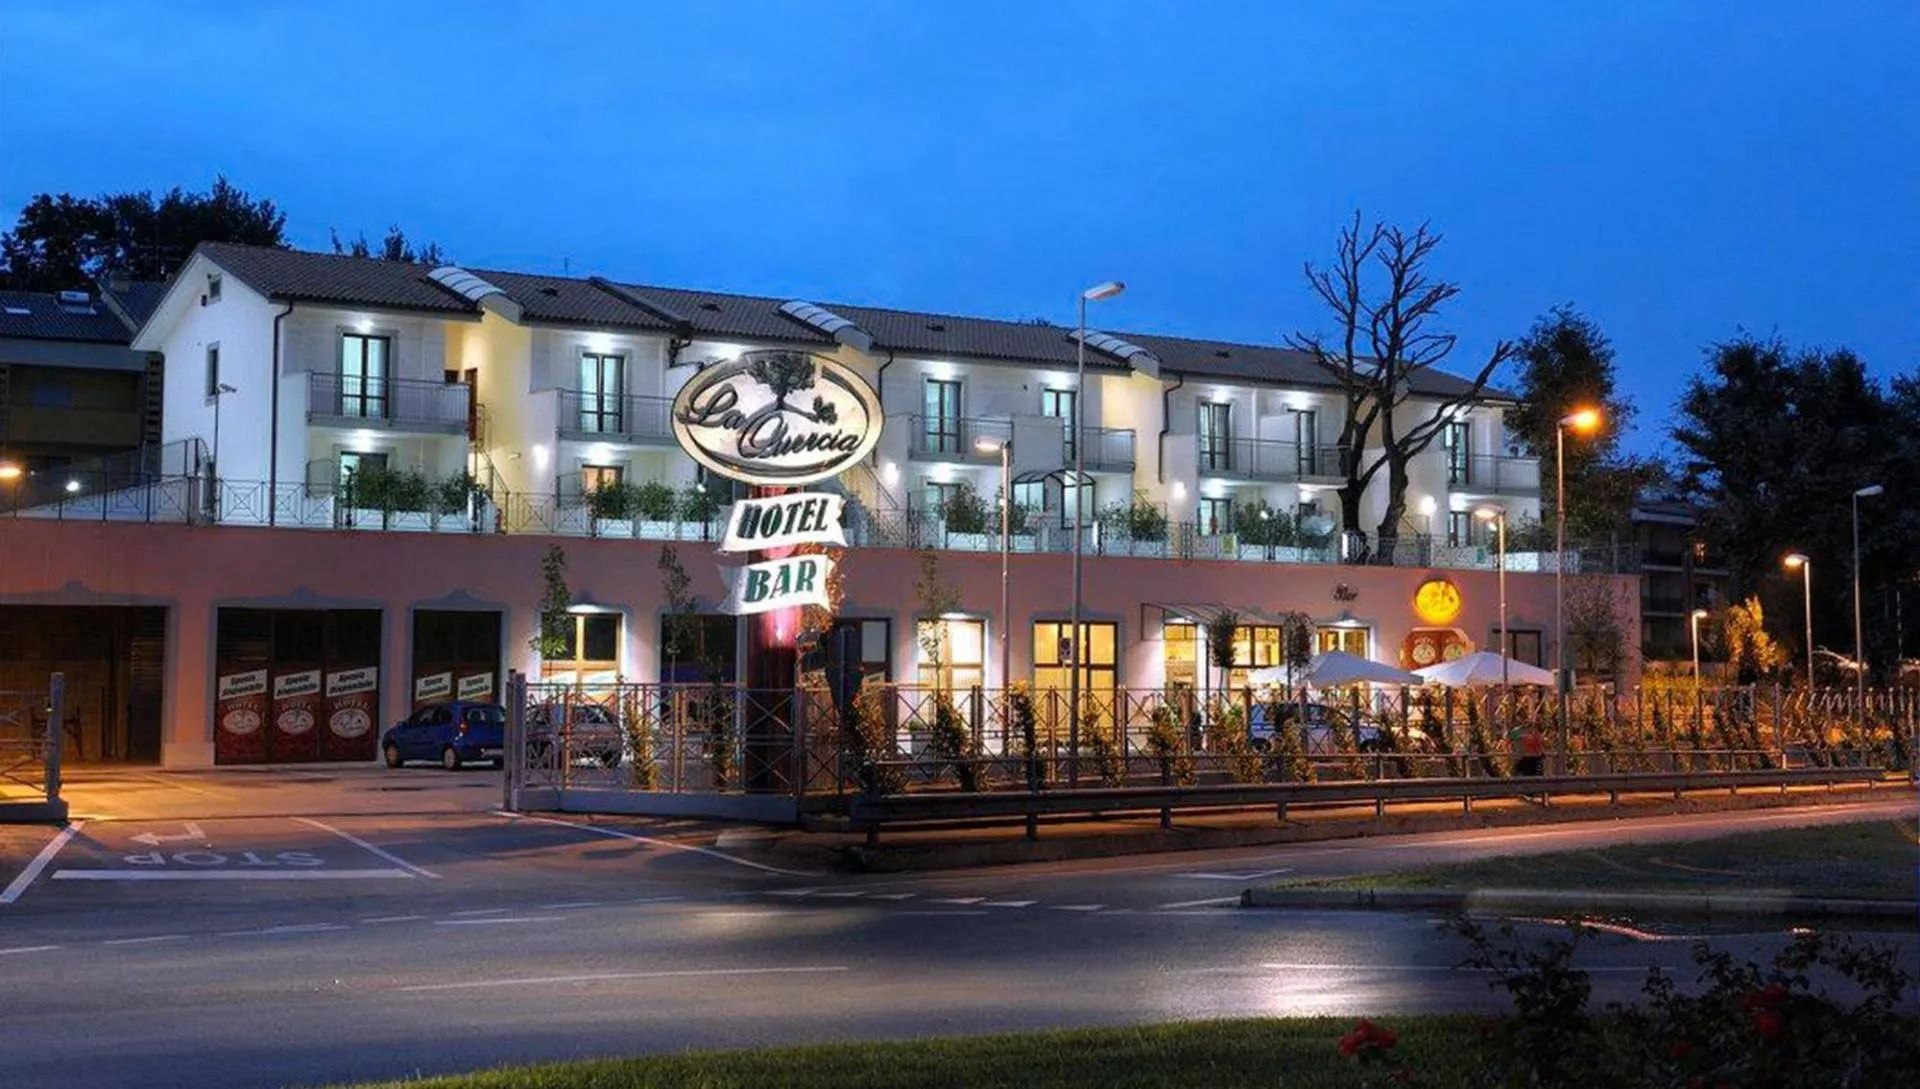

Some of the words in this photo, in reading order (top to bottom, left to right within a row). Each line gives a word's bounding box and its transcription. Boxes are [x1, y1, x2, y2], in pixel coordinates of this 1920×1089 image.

[682, 383, 747, 430] La
[736, 498, 829, 539] HOTEL
[745, 559, 817, 602] BAR
[123, 851, 326, 866] STOP
